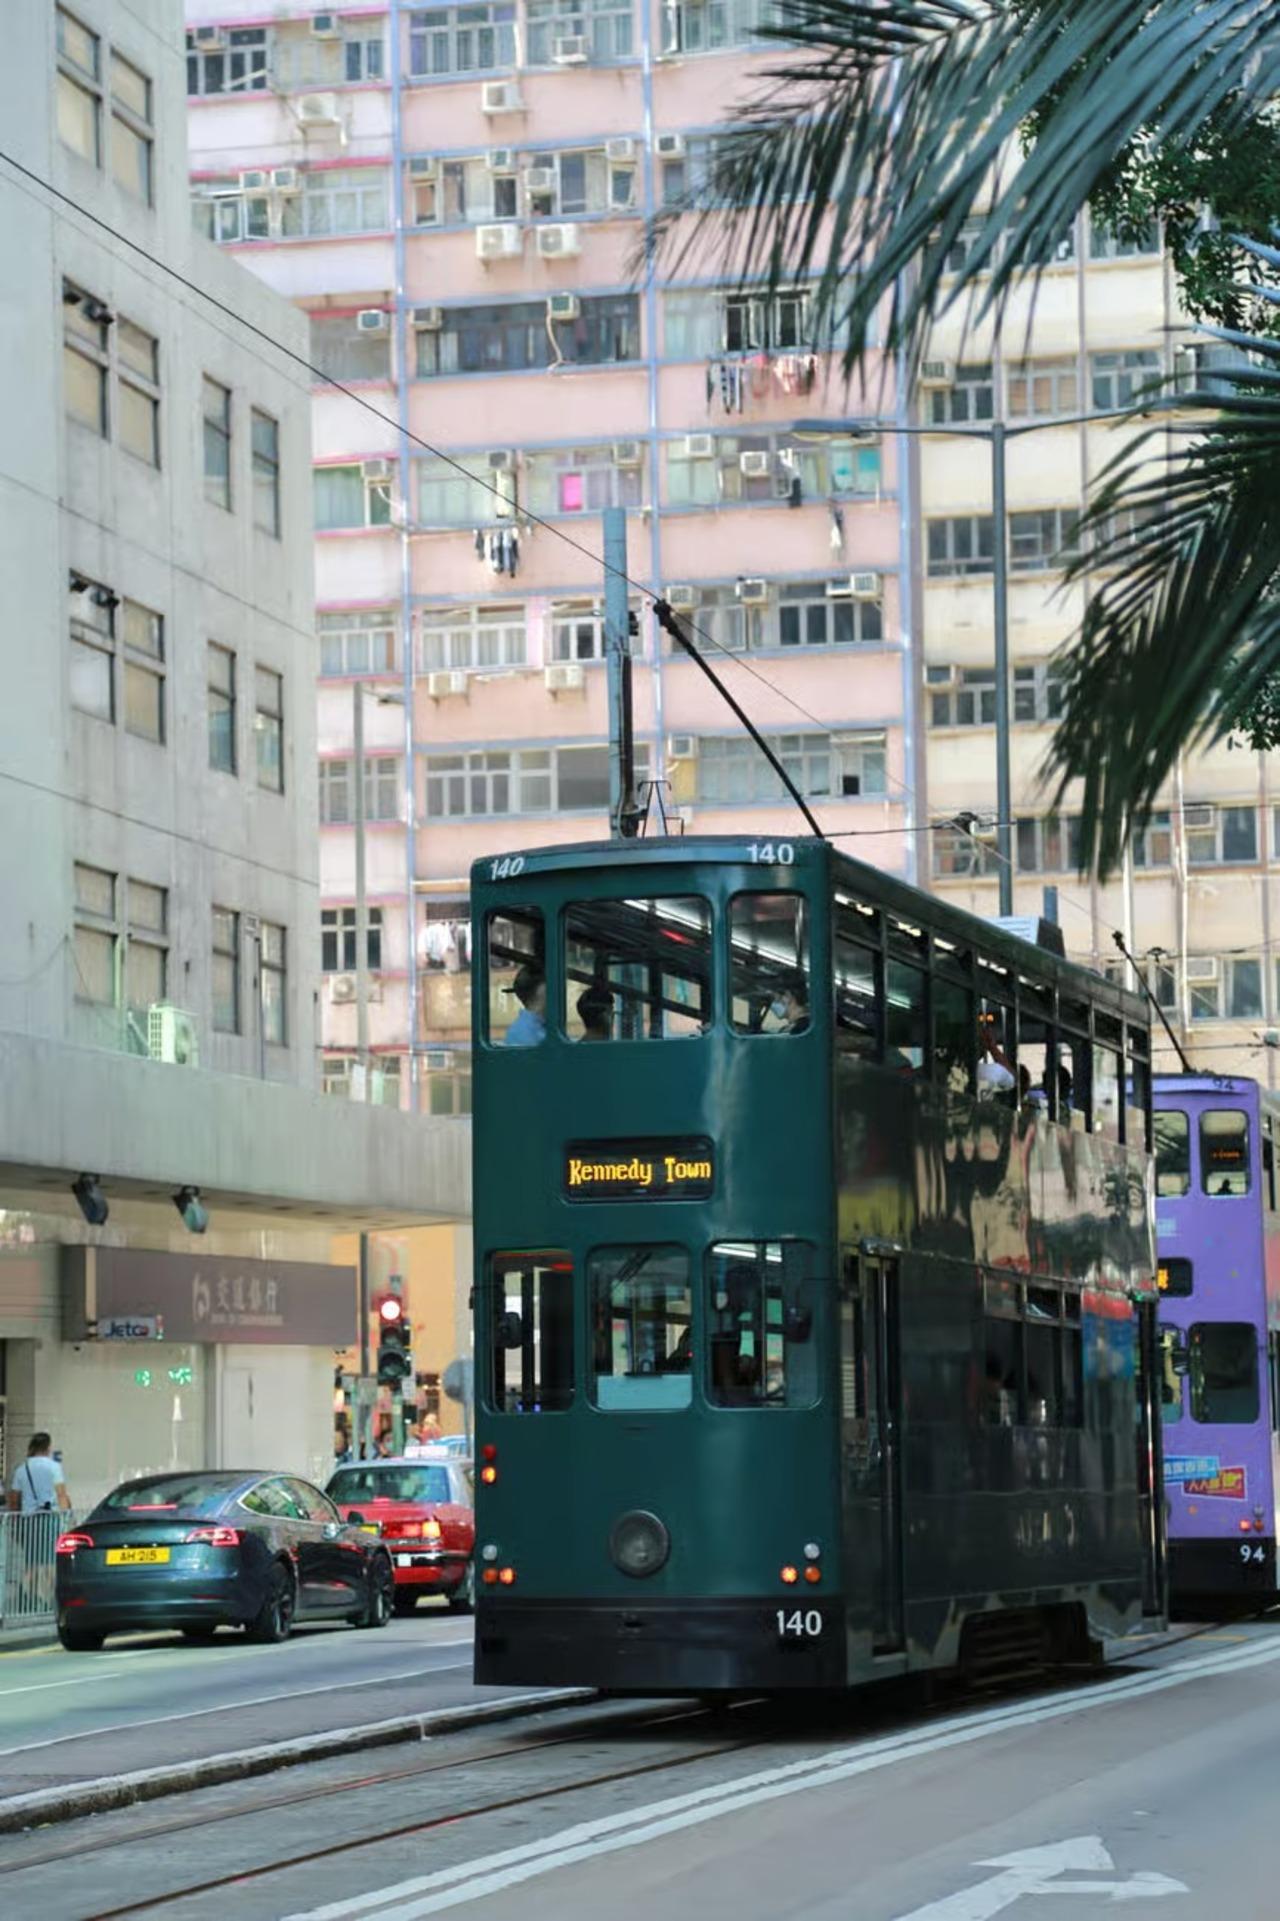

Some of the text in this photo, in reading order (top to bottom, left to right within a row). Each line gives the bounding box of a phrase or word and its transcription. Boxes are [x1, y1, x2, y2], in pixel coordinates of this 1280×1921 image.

[748, 843, 795, 865] 140
[490, 856, 525, 881] 140
[569, 1157, 711, 1185] Kennedy Town
[138, 1549, 158, 1562] 215
[1240, 1544, 1266, 1562] 94
[776, 1610, 822, 1636] 140
